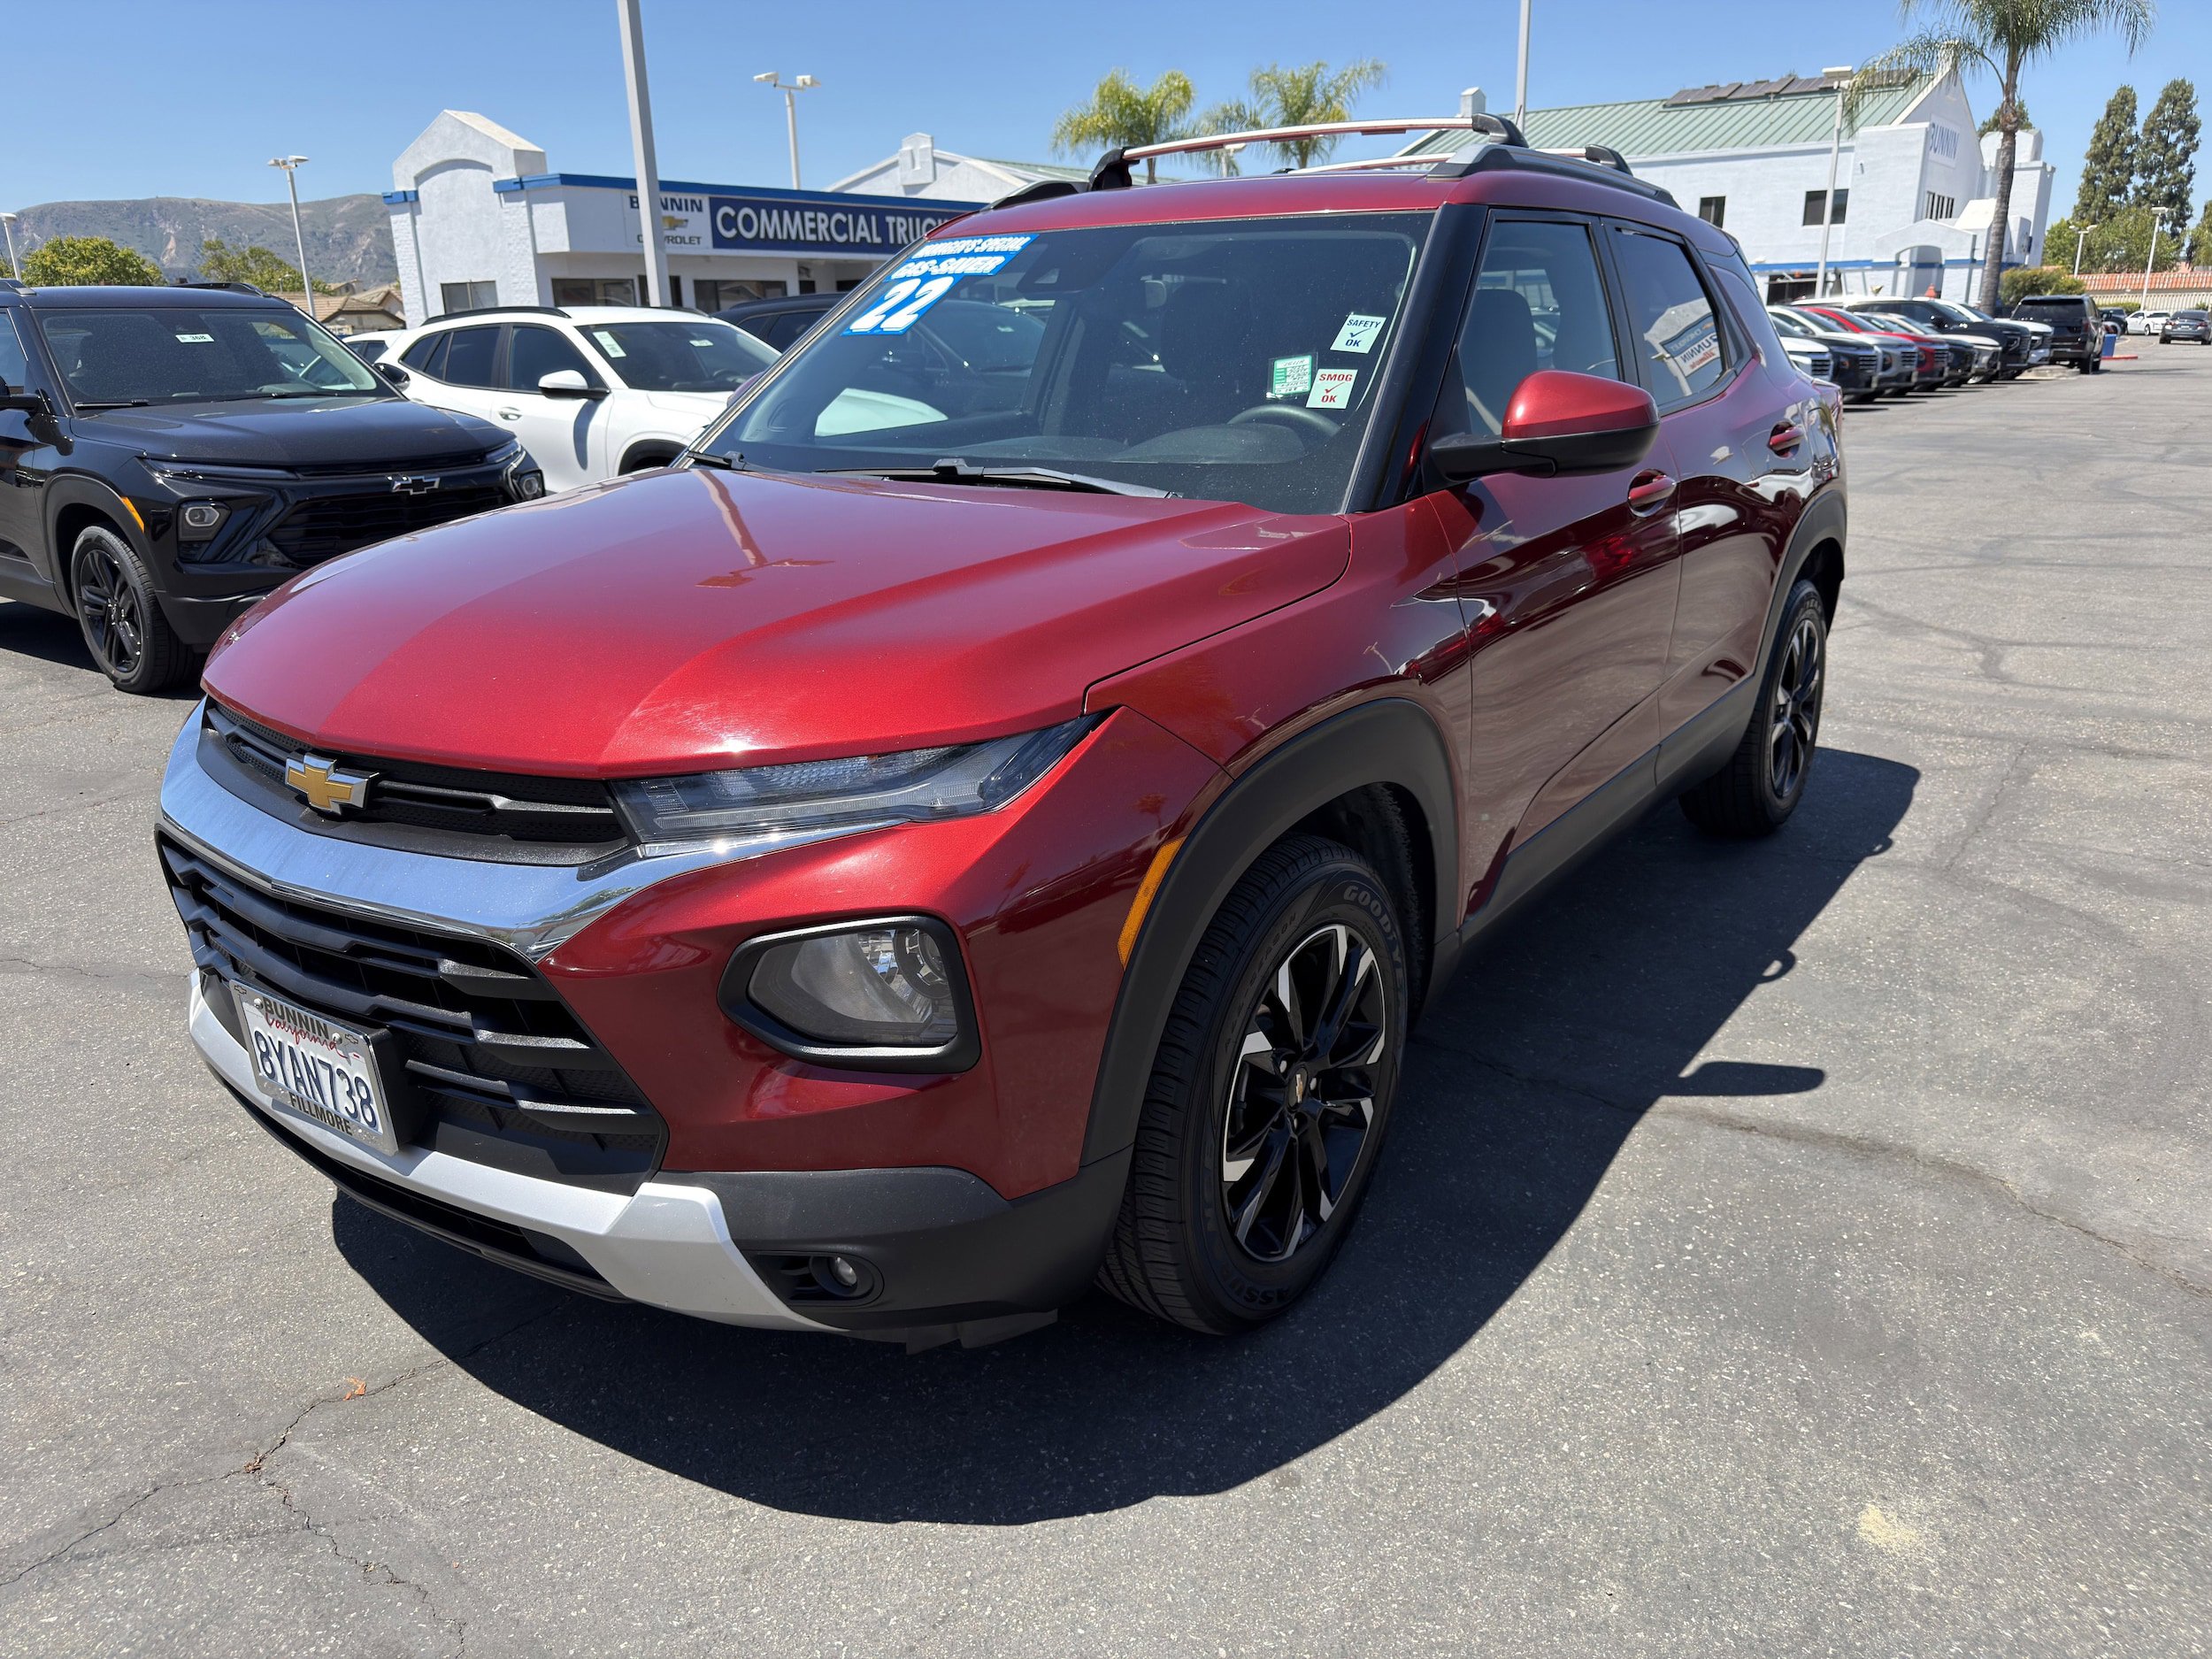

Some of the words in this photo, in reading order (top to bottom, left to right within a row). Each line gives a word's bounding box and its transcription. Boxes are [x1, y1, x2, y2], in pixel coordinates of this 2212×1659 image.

[629, 196, 703, 212] BNNIN
[716, 205, 881, 244] COMMERCIAL
[885, 215, 949, 245] TRUC
[637, 234, 702, 245] CROLET
[973, 236, 1031, 254] SPECIAL
[849, 276, 954, 332] 22
[1347, 319, 1381, 329] SAFETY
[1345, 339, 1362, 348] OK
[1318, 373, 1353, 382] SMOG
[1321, 395, 1337, 403] OK
[262, 996, 330, 1040] BUNNIN
[254, 1030, 377, 1133] 8YAN738
[288, 1091, 353, 1136] FILLMORE
